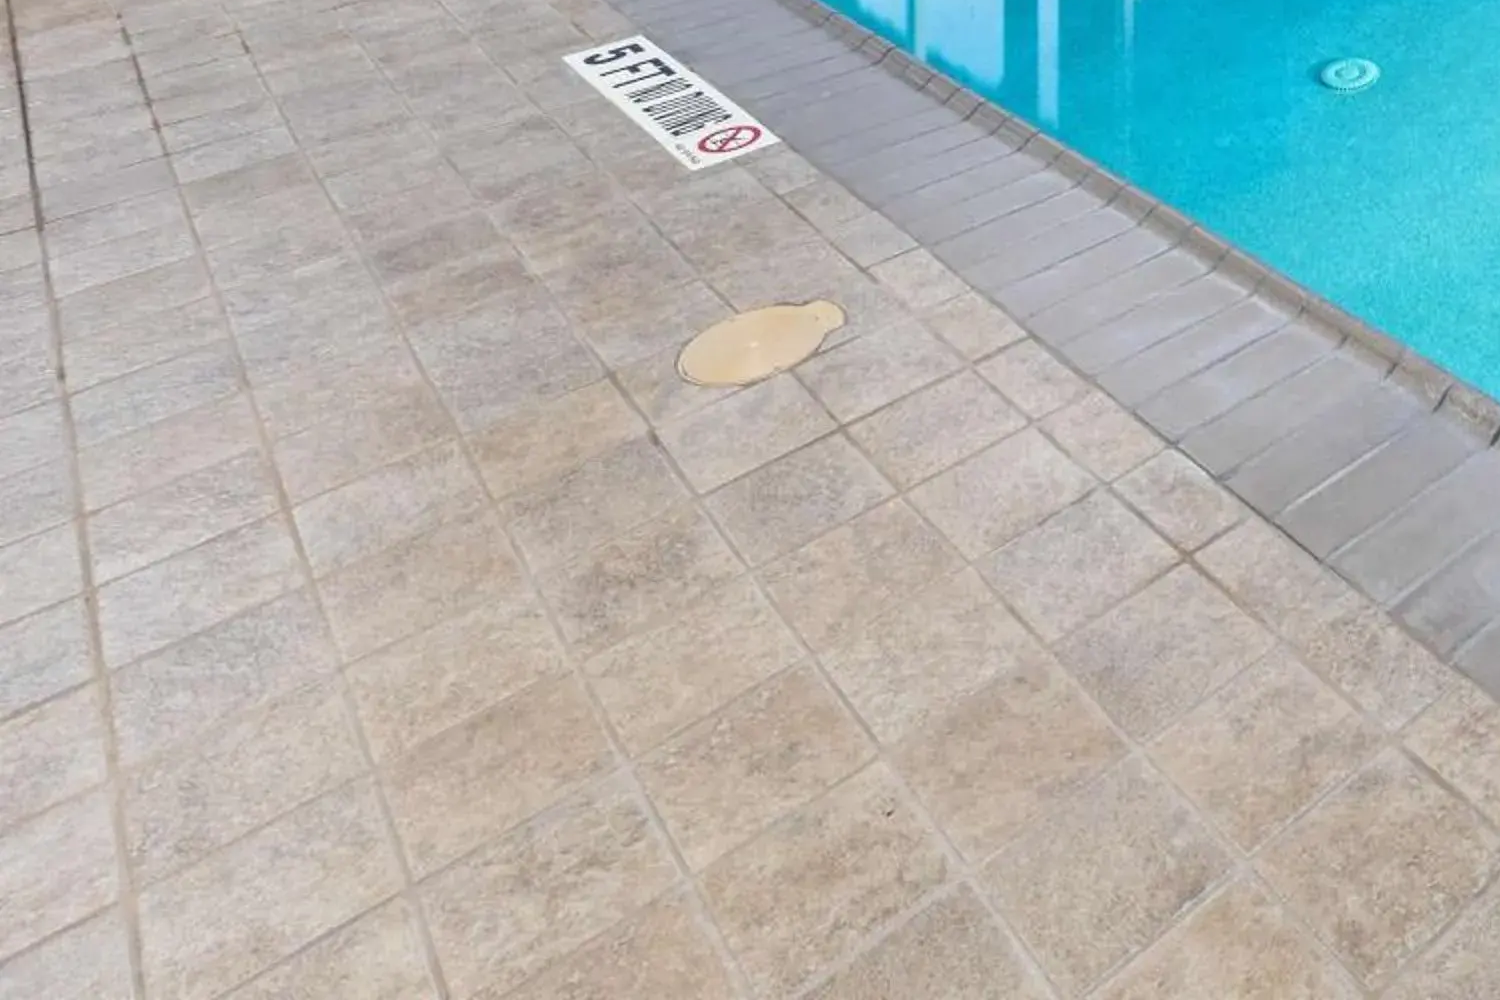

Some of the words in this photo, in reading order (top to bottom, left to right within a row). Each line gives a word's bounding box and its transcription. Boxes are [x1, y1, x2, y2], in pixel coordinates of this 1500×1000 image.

[583, 43, 645, 65] 5
[600, 57, 676, 89] FT
[624, 77, 694, 104] NO
[641, 91, 732, 137] DIVING
